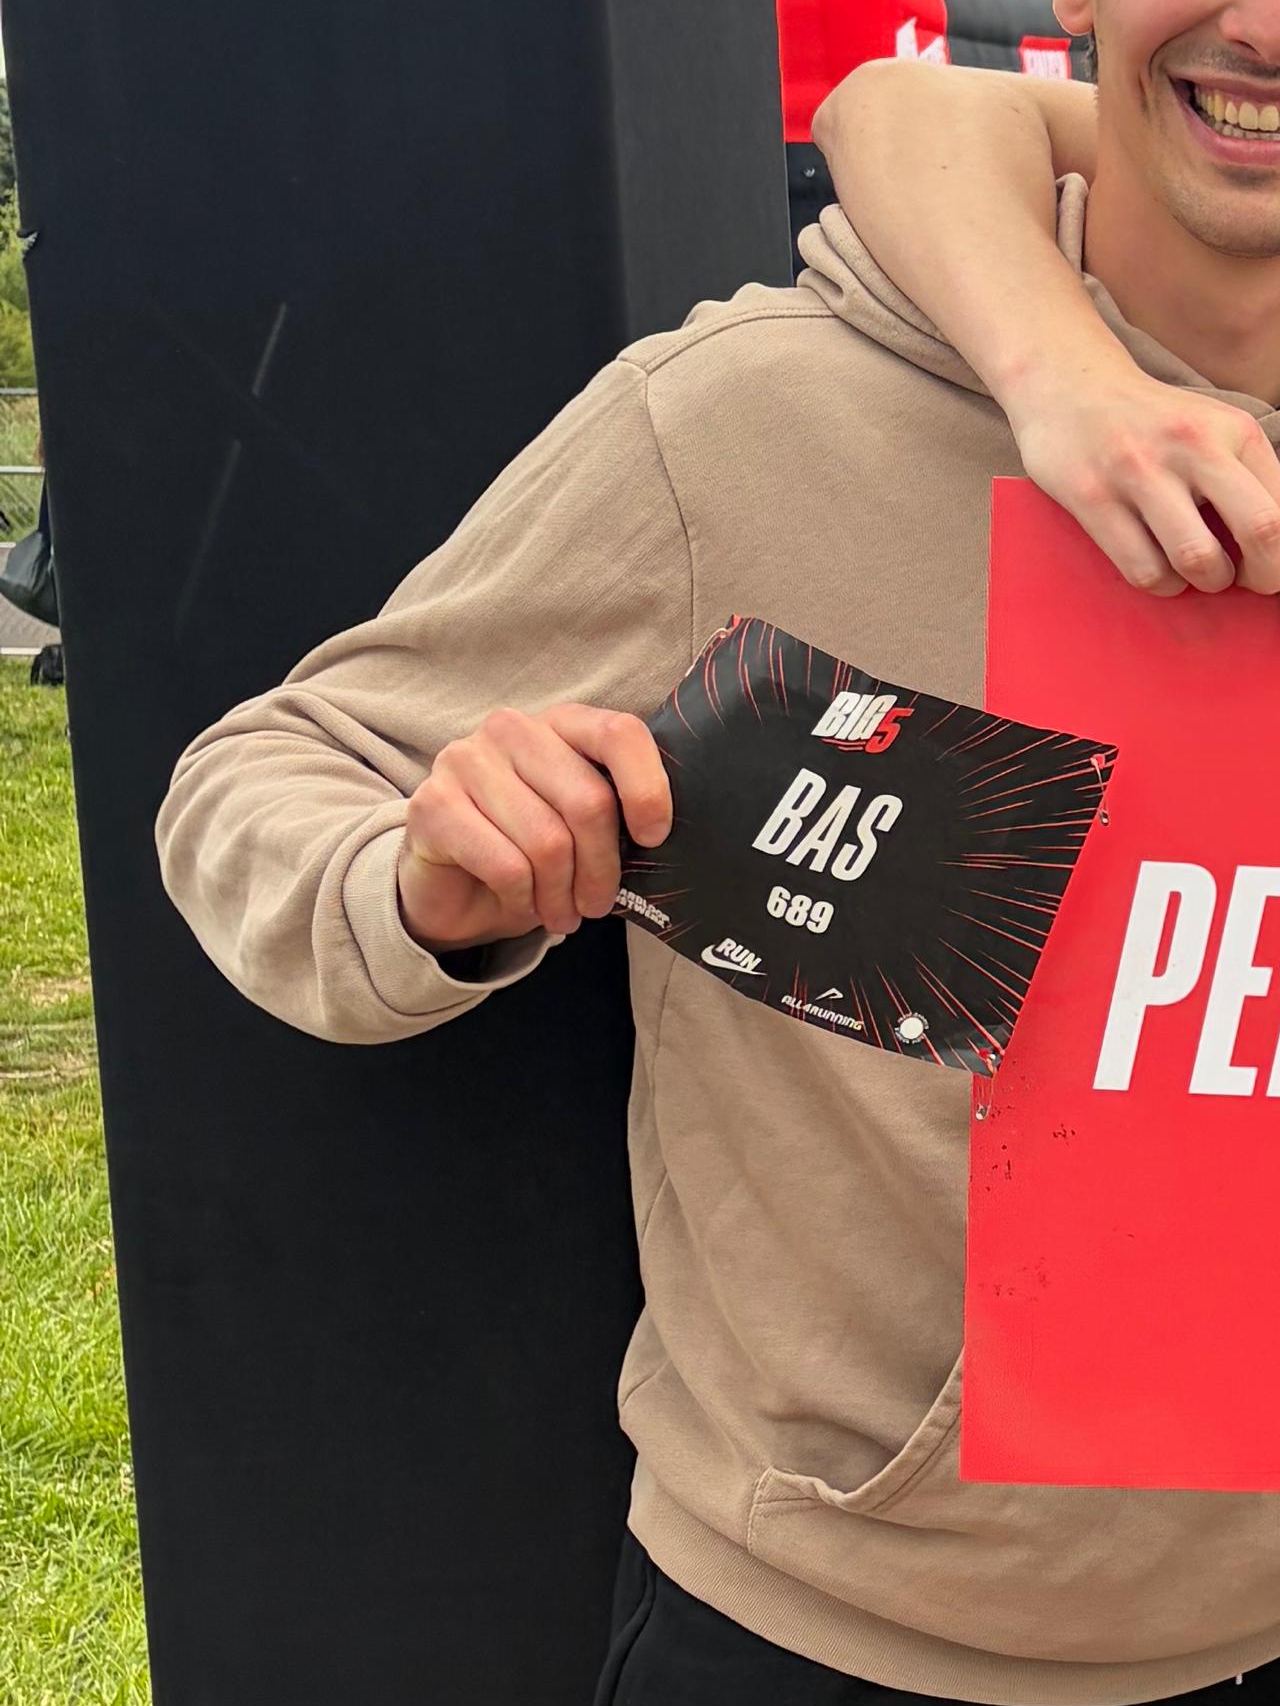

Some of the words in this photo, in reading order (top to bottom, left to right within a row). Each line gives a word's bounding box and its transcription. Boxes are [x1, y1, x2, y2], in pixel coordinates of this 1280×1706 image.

[752, 767, 903, 881] BAS
[766, 886, 835, 934] 689
[716, 938, 761, 972] RUN
